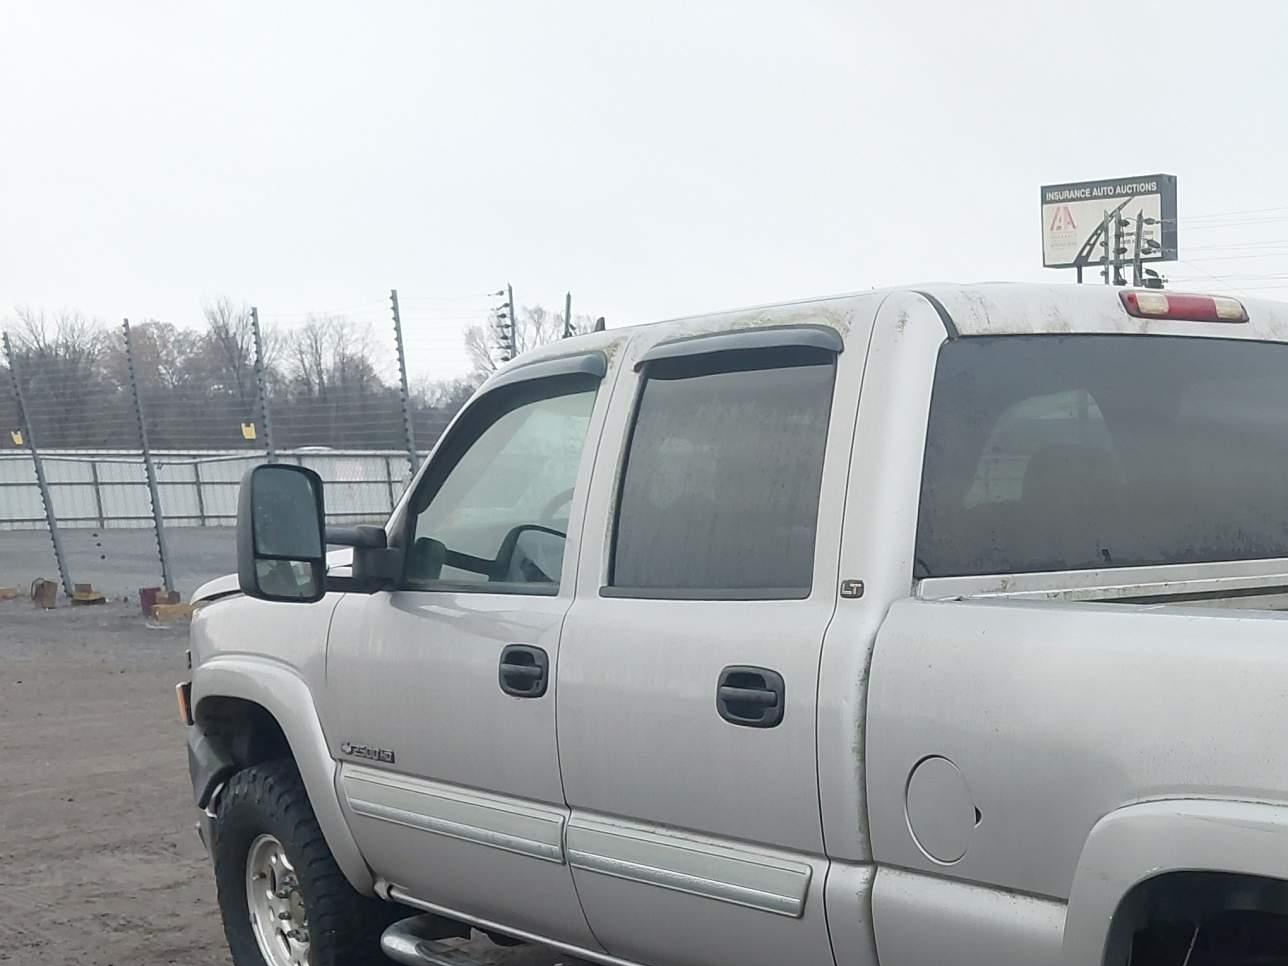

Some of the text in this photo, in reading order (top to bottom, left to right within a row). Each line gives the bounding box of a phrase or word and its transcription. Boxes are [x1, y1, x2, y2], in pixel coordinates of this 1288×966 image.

[1046, 181, 1157, 201] INSURANCE AUTO AUCTIONS
